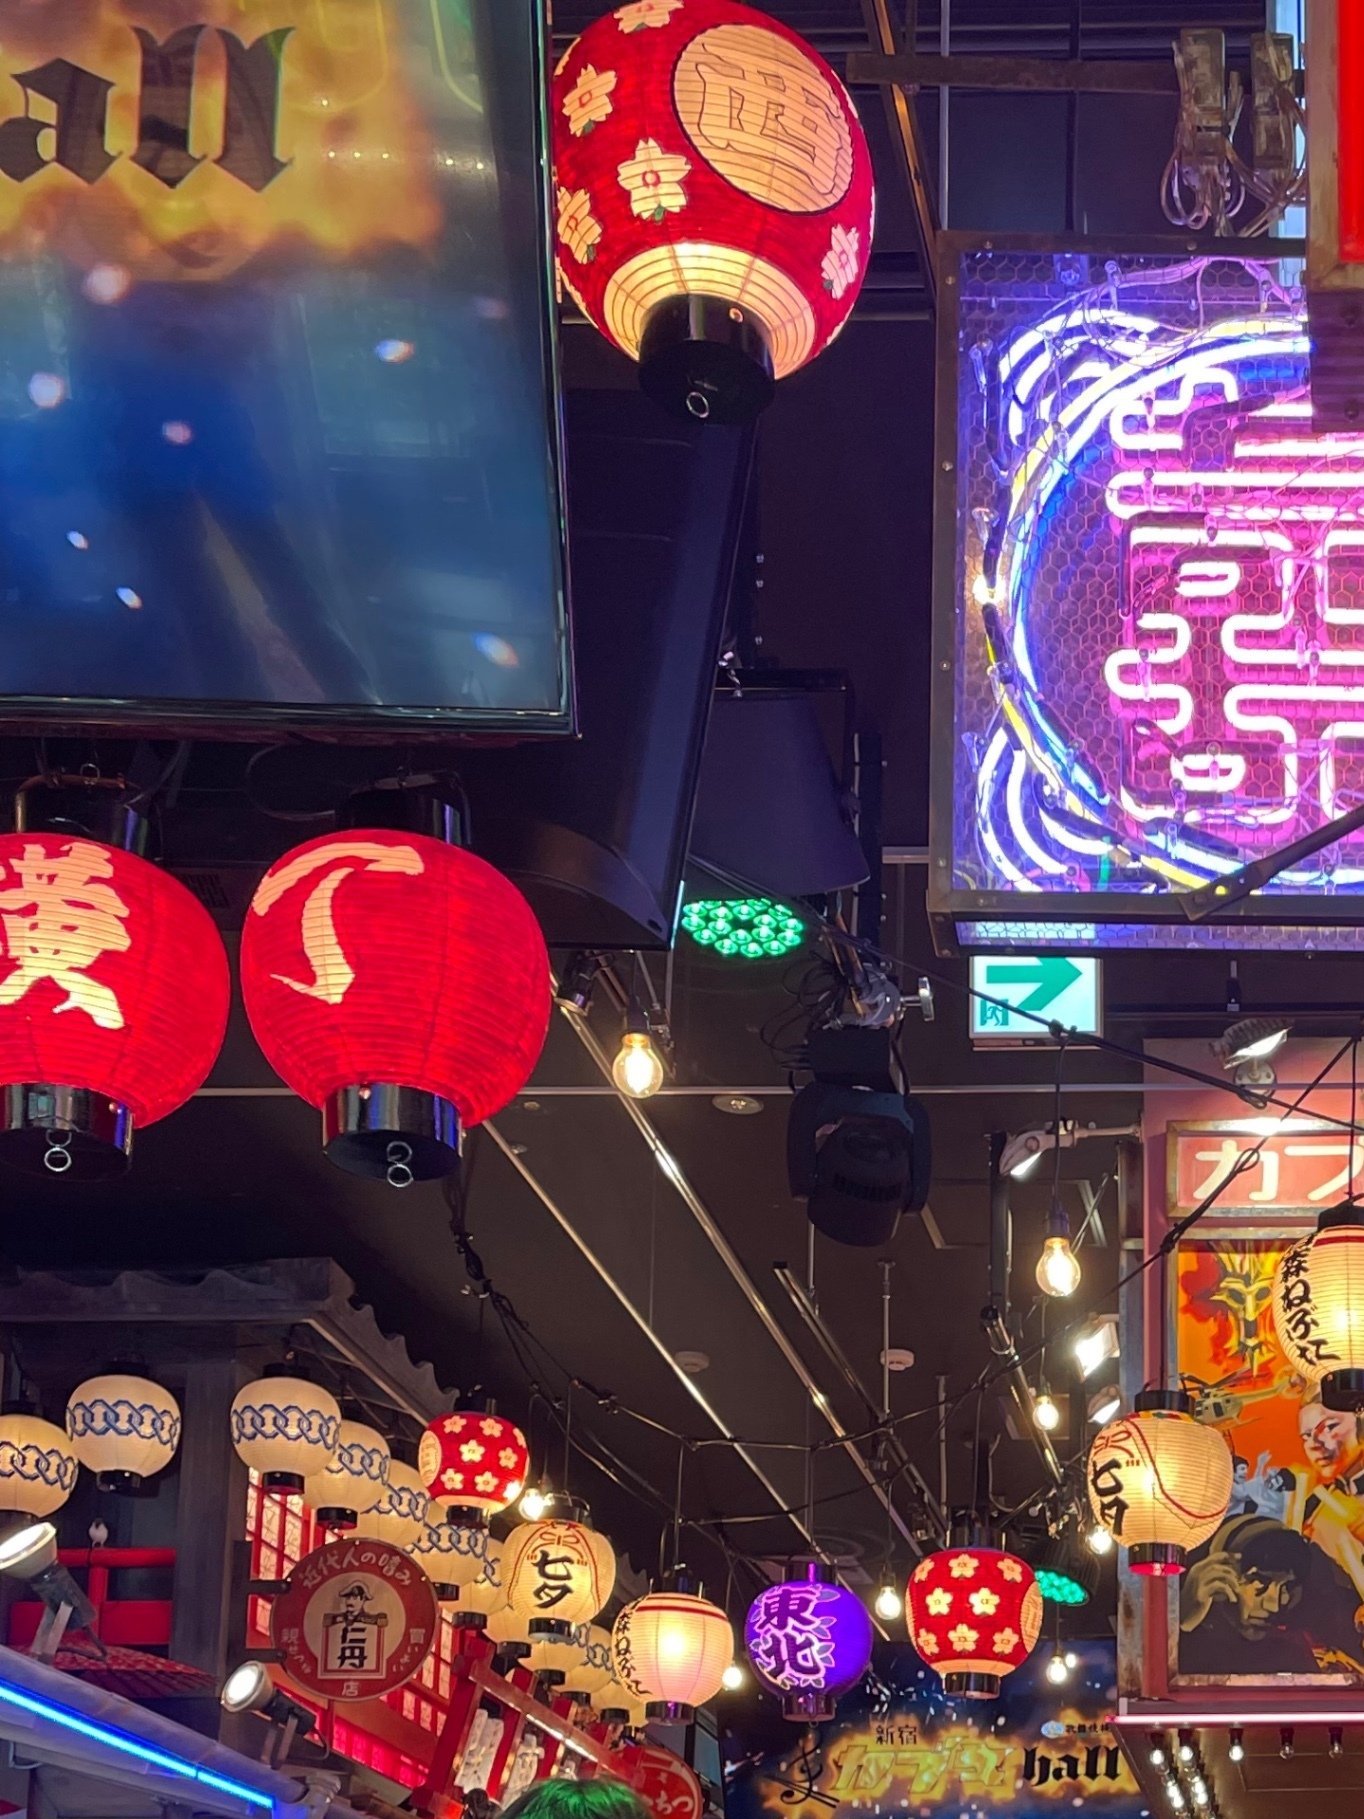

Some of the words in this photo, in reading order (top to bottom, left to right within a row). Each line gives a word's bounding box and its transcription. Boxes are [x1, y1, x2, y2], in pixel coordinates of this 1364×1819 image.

[1281, 1238, 1341, 1367] 森ねぶた
[530, 1549, 575, 1609] 七夕
[337, 1626, 368, 1669] 仁丹
[758, 1587, 825, 1683] 東北
[341, 1682, 360, 1697] 店
[875, 1724, 918, 1746] 新宿
[1023, 1745, 1122, 1787] hall
